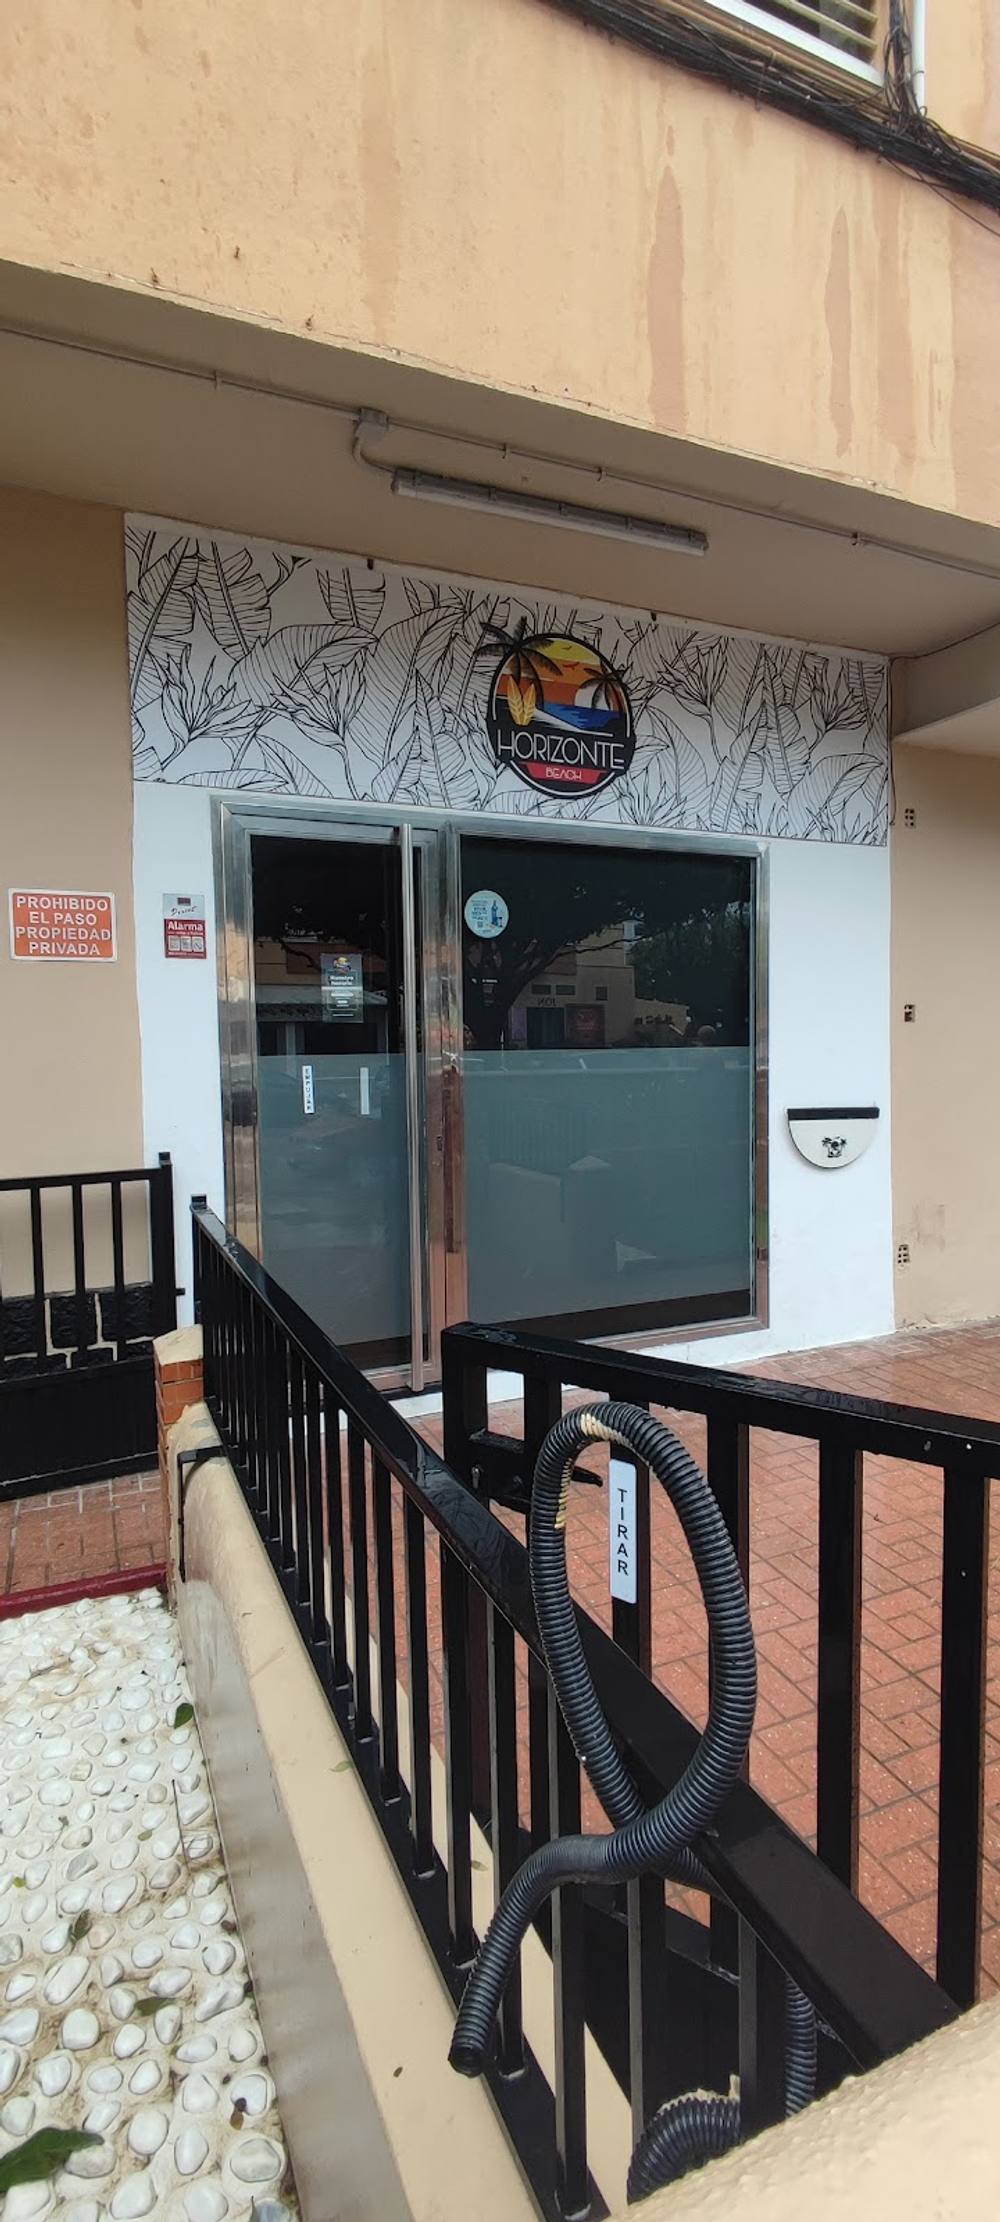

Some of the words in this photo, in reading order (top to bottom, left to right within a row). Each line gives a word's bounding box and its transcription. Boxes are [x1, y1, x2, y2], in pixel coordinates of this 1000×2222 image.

[497, 729, 625, 770] HORIZONTE
[545, 767, 582, 780] BEACH
[16, 895, 109, 912] PROHIBIDO
[29, 912, 50, 924] EL
[54, 912, 97, 926] PASO
[16, 926, 112, 941] PROPIEDAD
[29, 941, 101, 956] PRIVADA
[617, 1487, 629, 1576] TIRAR
